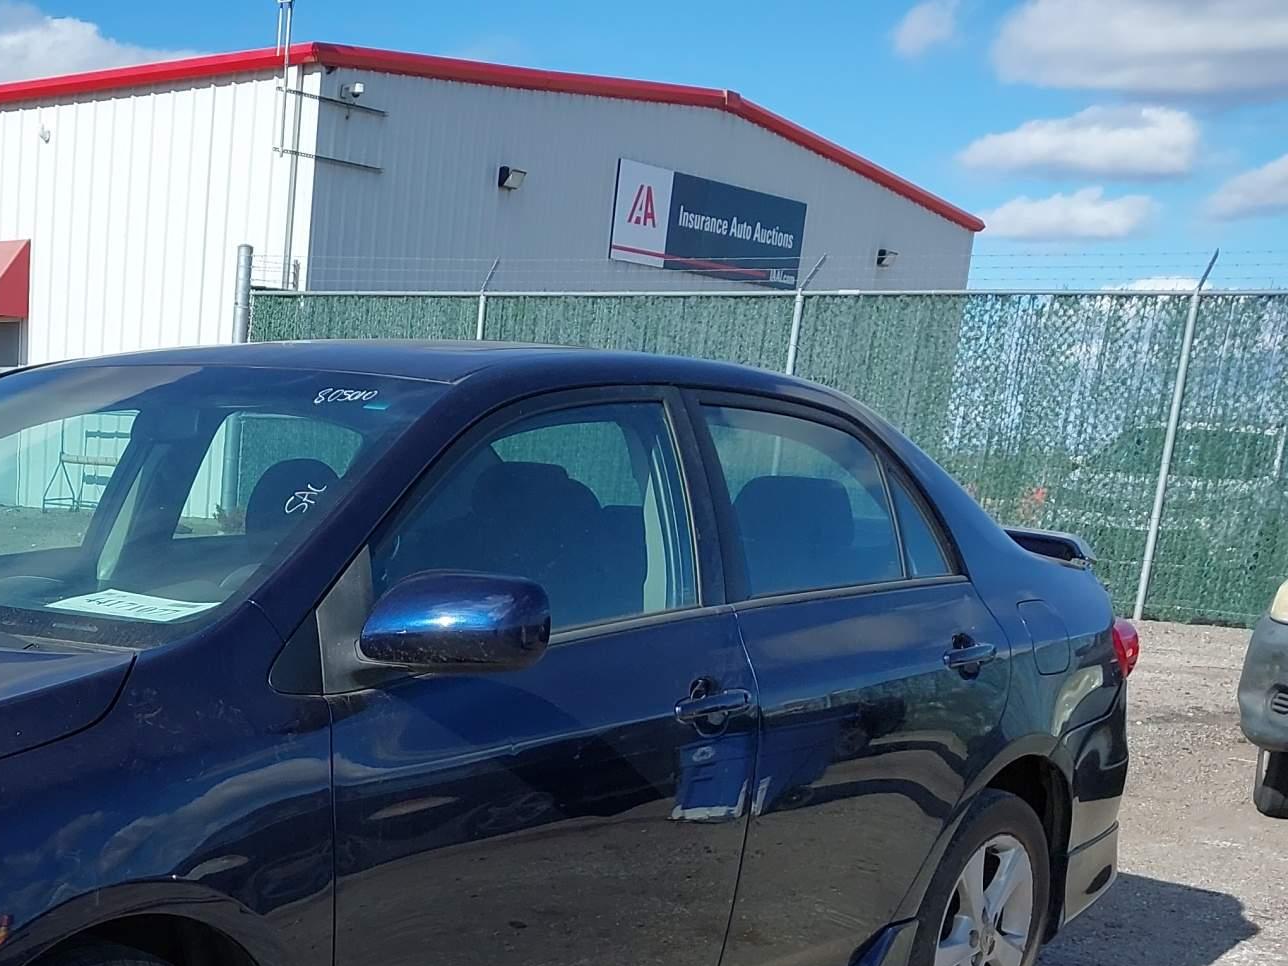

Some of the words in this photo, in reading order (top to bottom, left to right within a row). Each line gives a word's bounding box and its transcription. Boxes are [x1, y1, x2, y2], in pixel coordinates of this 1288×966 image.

[678, 205, 728, 236] Insurance
[729, 217, 752, 240] Auto
[753, 222, 794, 249] Auctions
